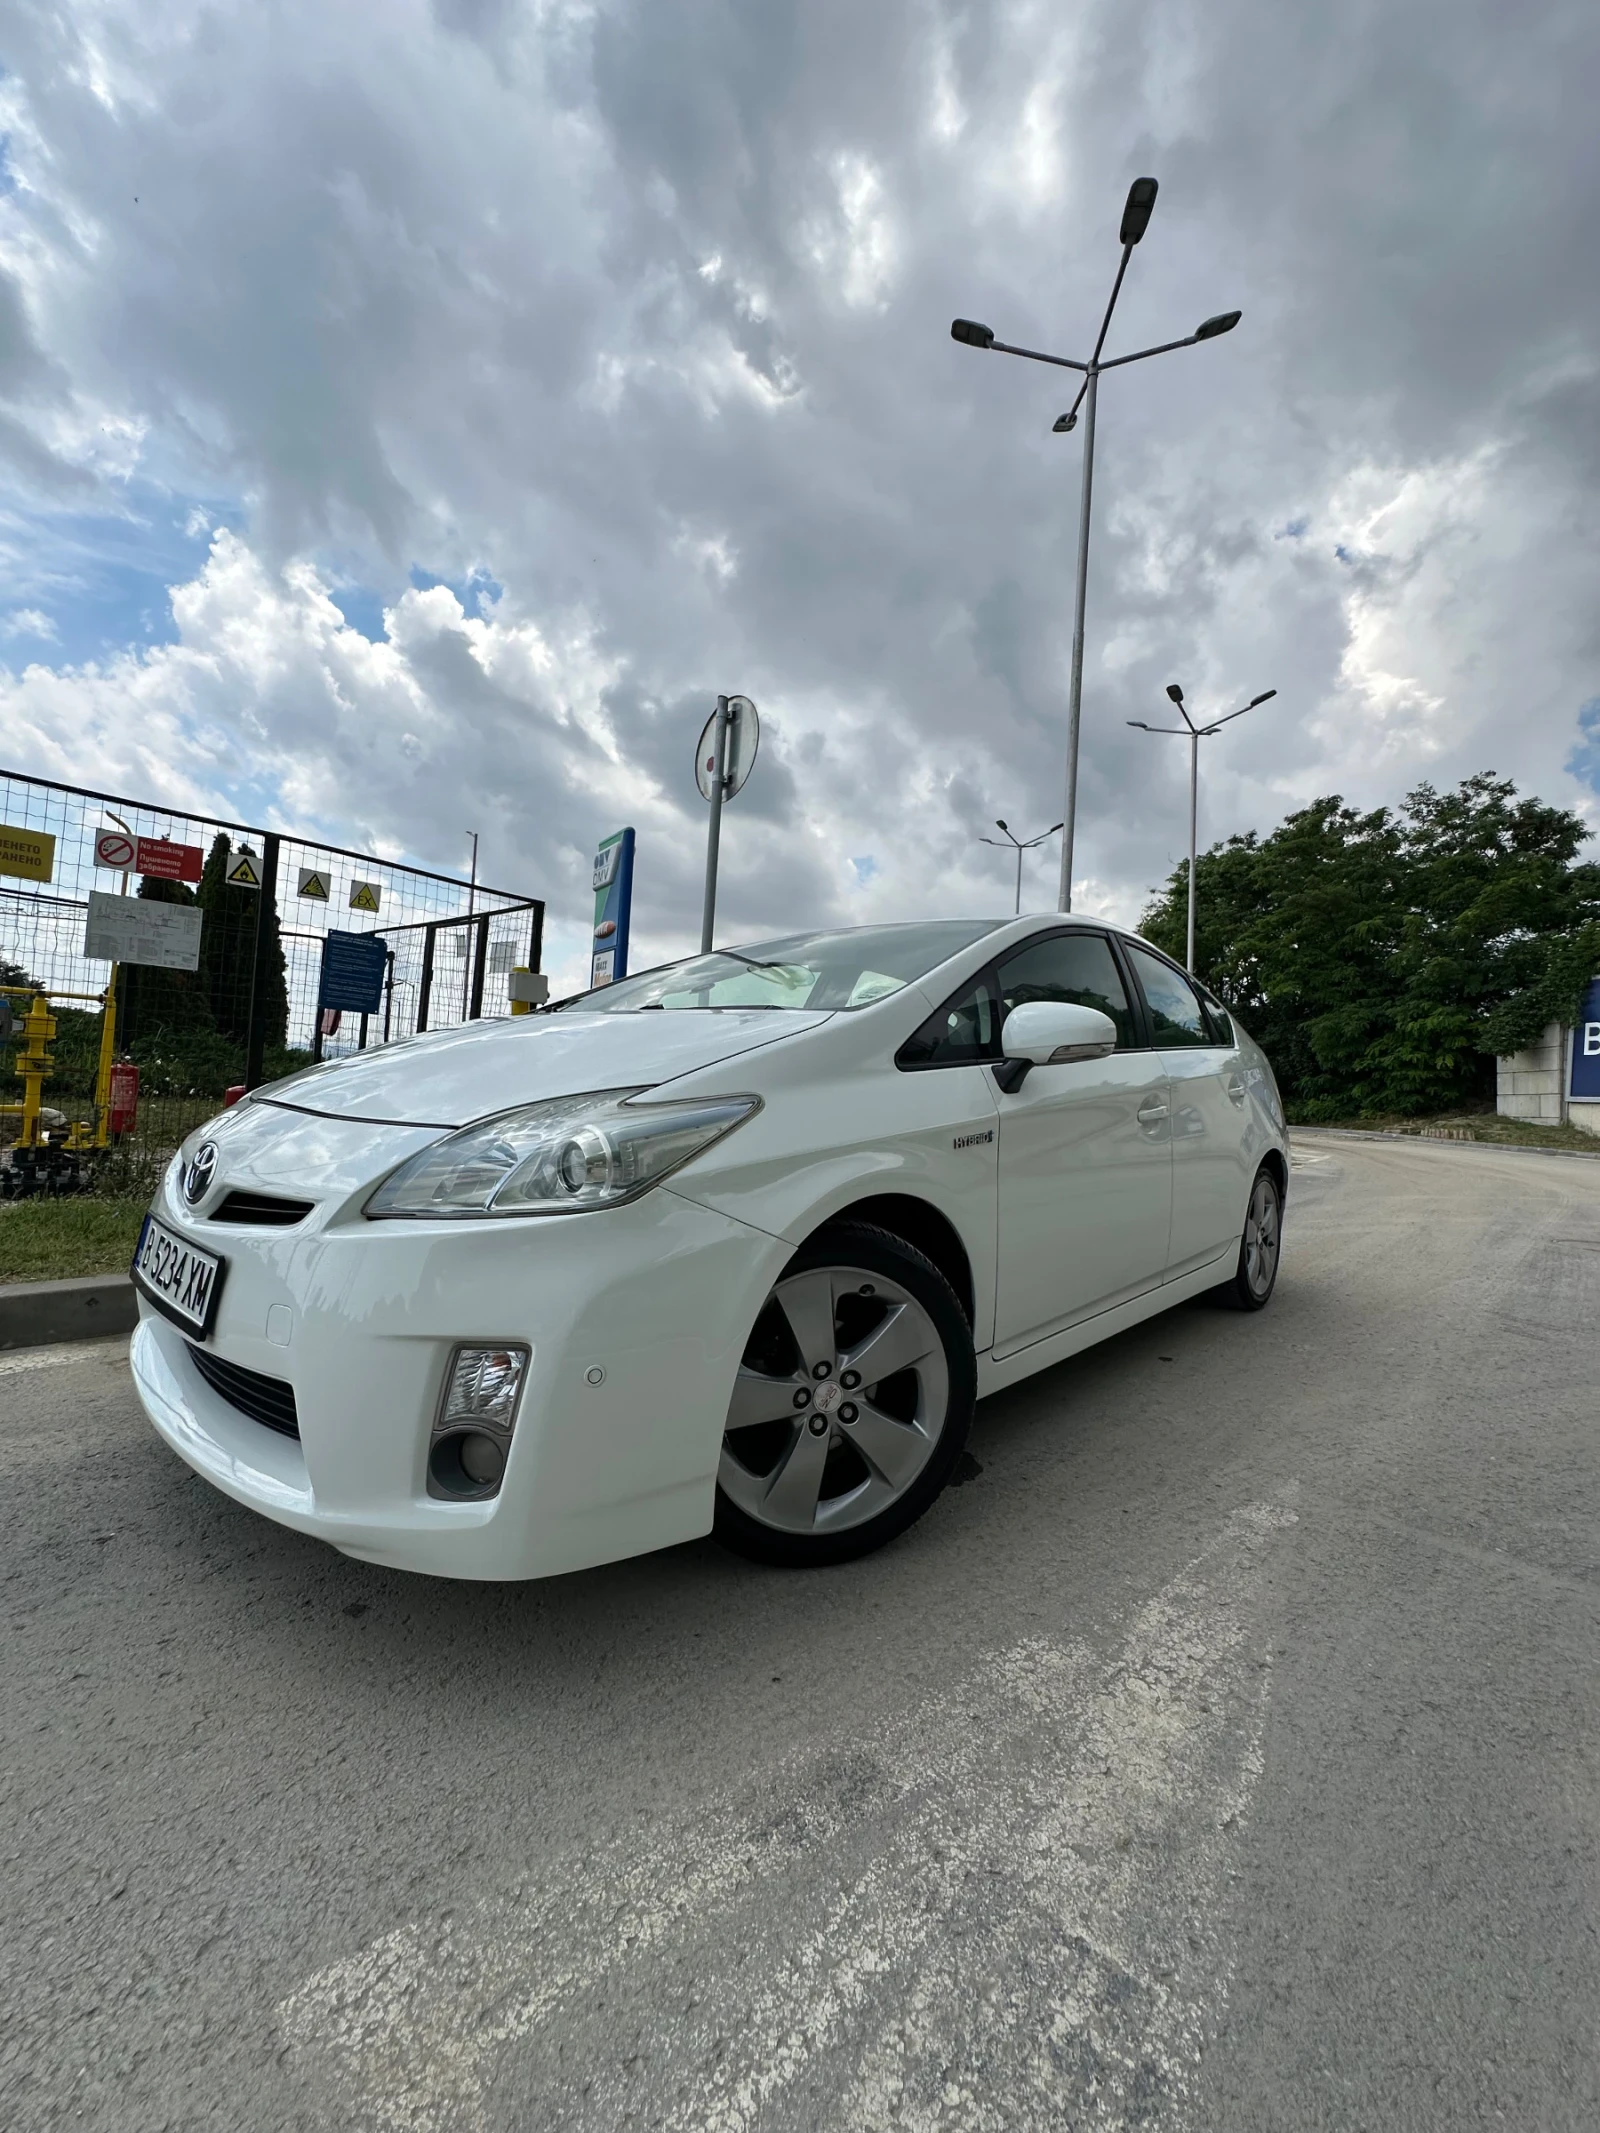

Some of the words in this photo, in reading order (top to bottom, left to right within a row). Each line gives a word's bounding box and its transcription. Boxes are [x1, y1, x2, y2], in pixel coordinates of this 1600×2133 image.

[140, 841, 152, 849] No
[153, 845, 184, 857] smoking
[140, 853, 181, 867] Пушенето
[139, 863, 180, 875] забранено
[593, 866, 609, 885] OMV
[358, 895, 371, 906] EX
[953, 1131, 988, 1149] HYBRID
[150, 1234, 189, 1298] 5234
